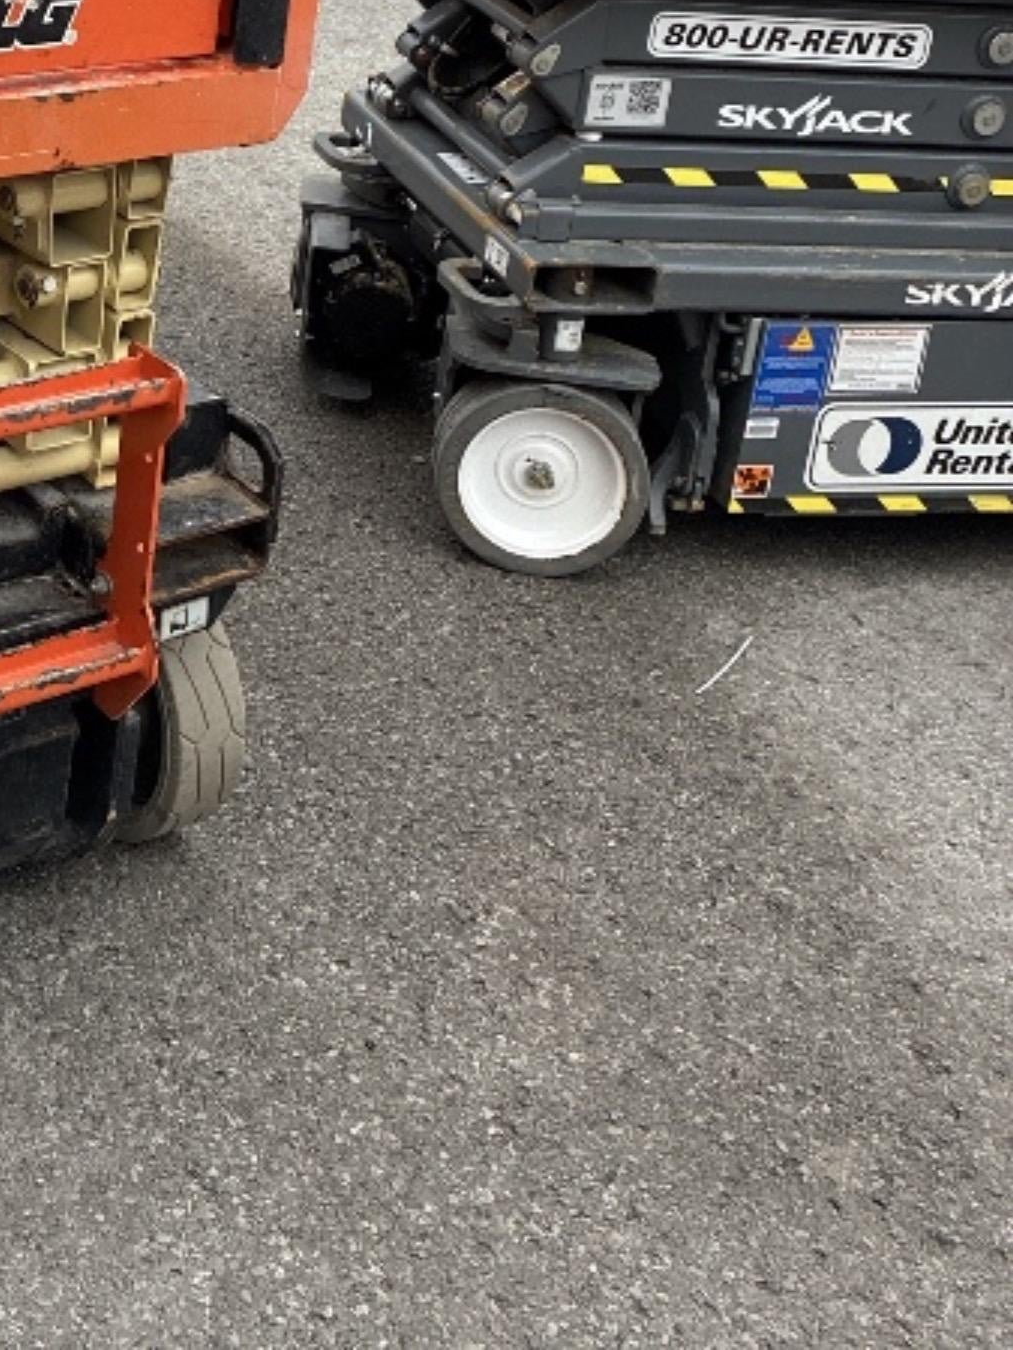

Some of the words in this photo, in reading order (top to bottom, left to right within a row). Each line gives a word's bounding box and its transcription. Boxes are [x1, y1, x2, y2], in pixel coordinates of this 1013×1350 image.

[664, 23, 917, 58] 800-UR-RENTS
[717, 93, 912, 136] SKYJACK
[933, 416, 1013, 445] Unit
[924, 448, 1013, 475] Rent
